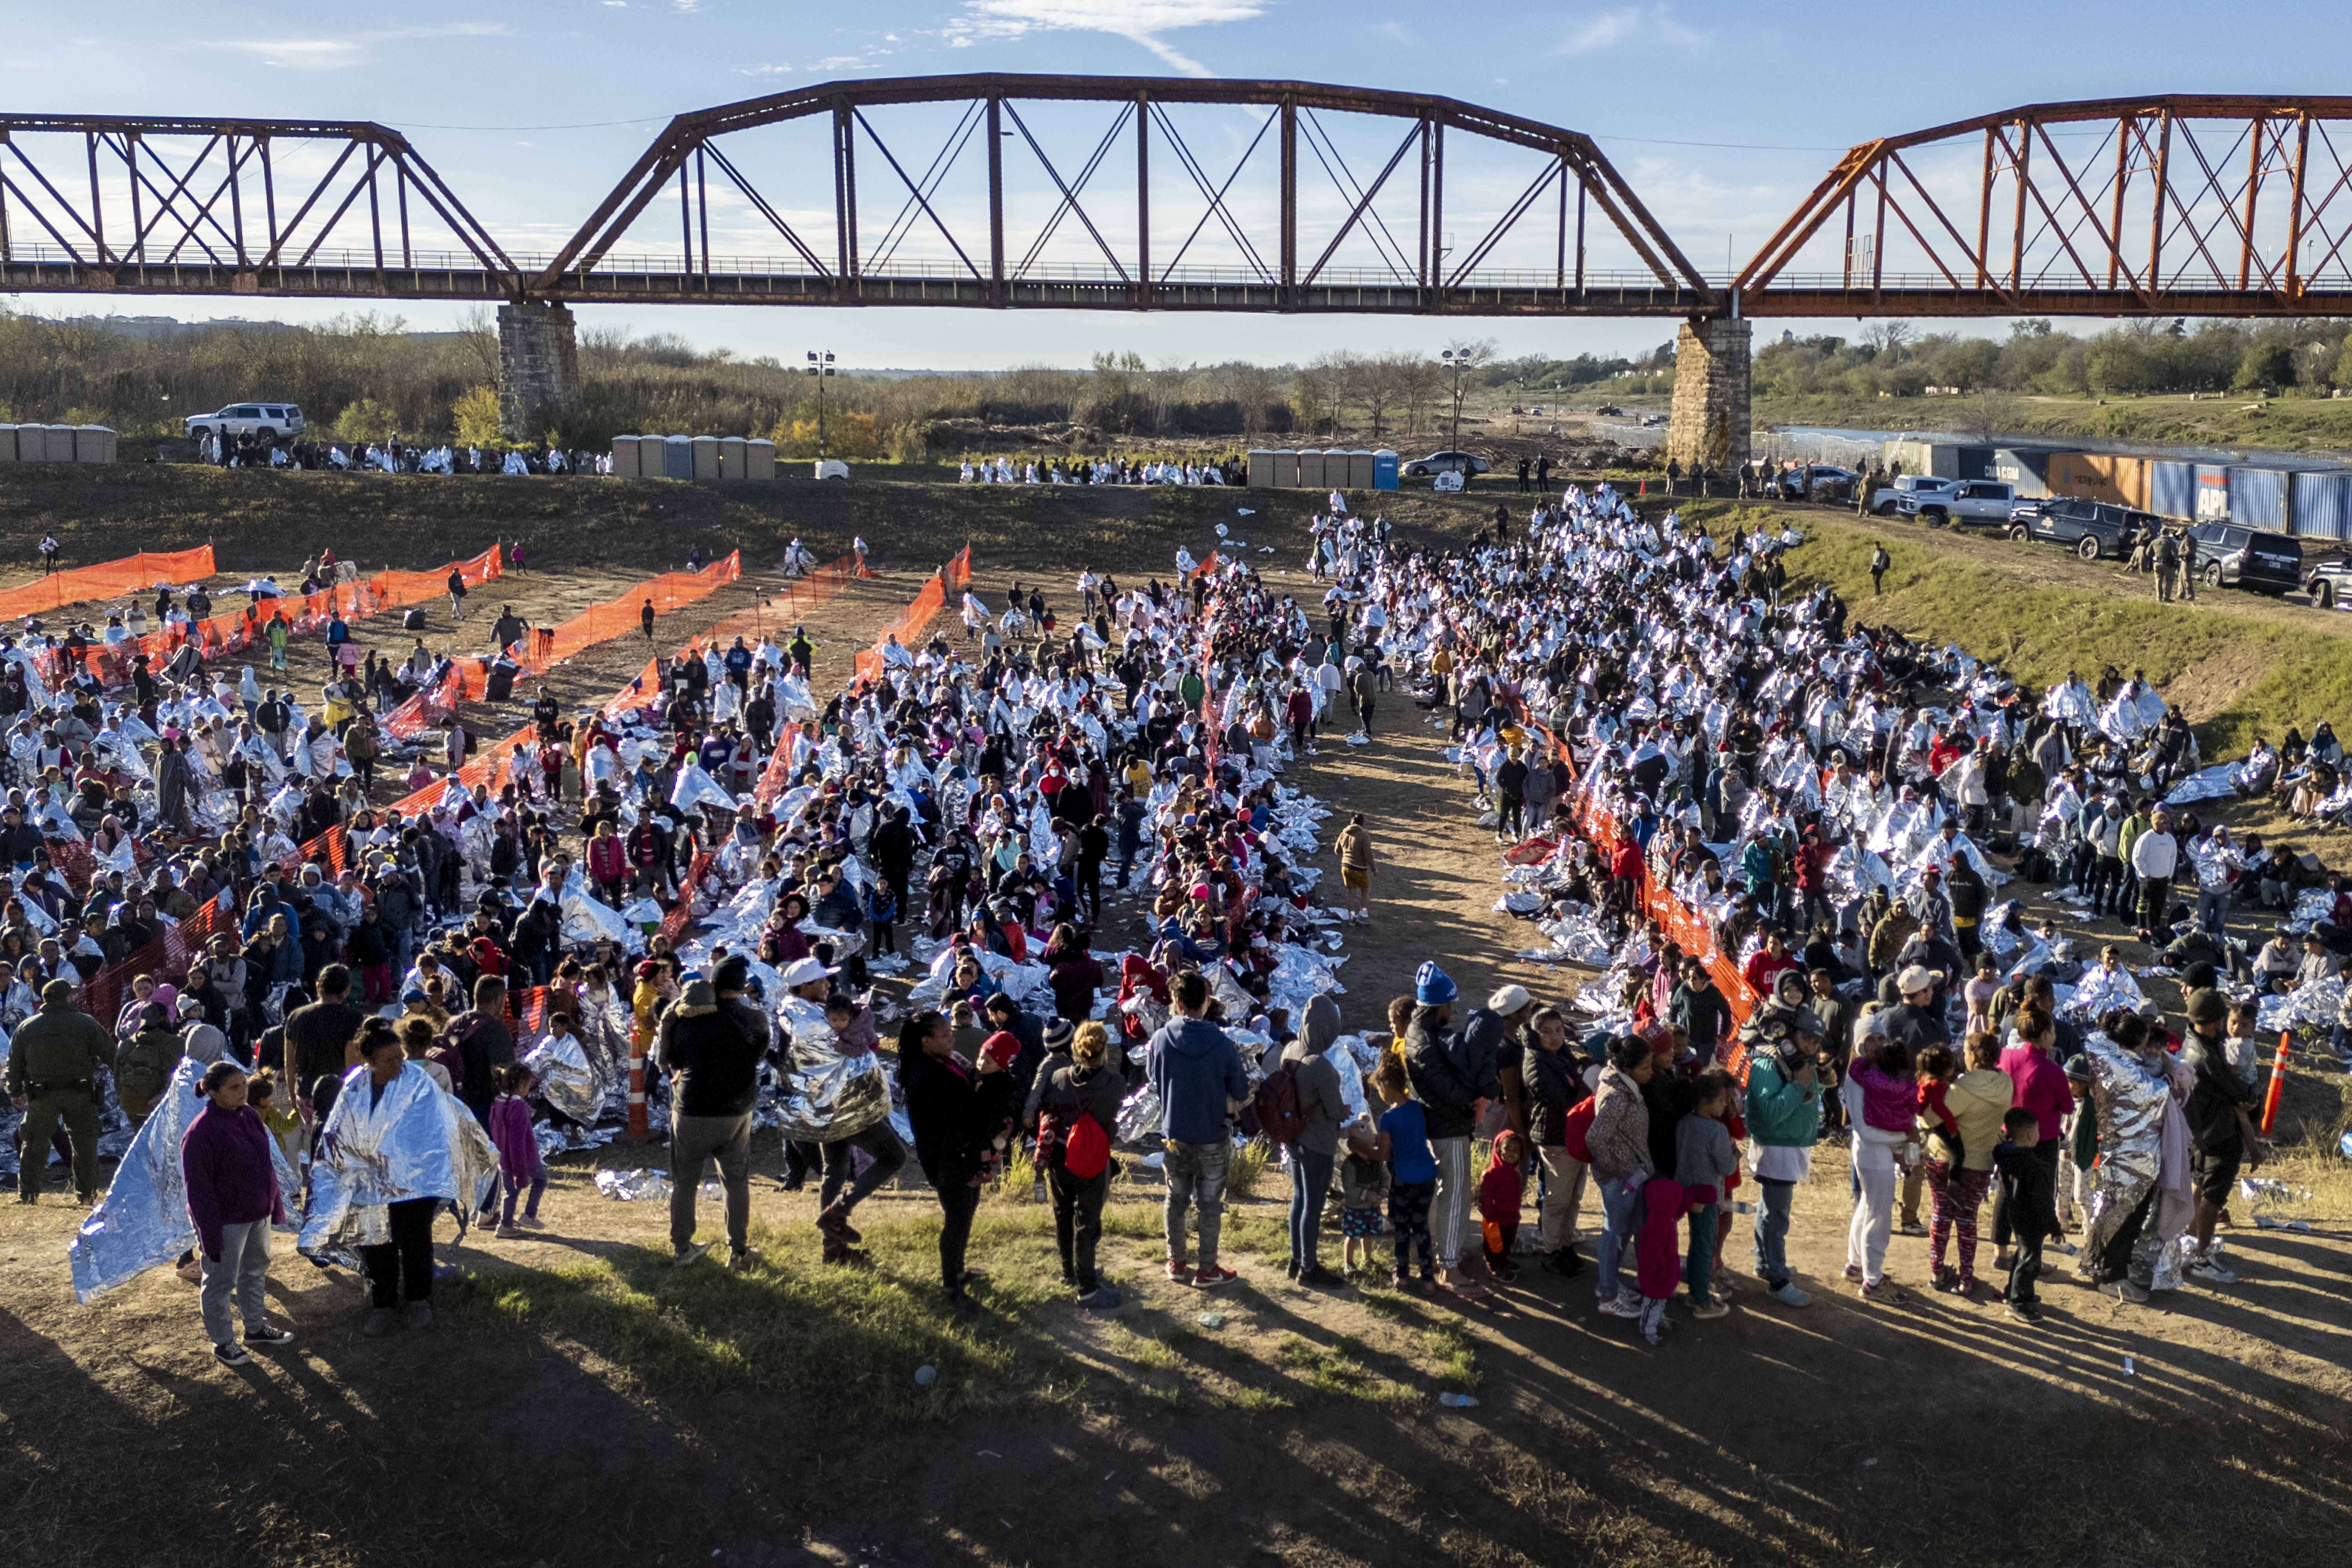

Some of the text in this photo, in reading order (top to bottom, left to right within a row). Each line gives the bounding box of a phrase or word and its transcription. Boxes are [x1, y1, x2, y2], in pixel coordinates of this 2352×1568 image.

[1985, 465, 2019, 479] CMA CGM
[2197, 487, 2231, 517] APL
